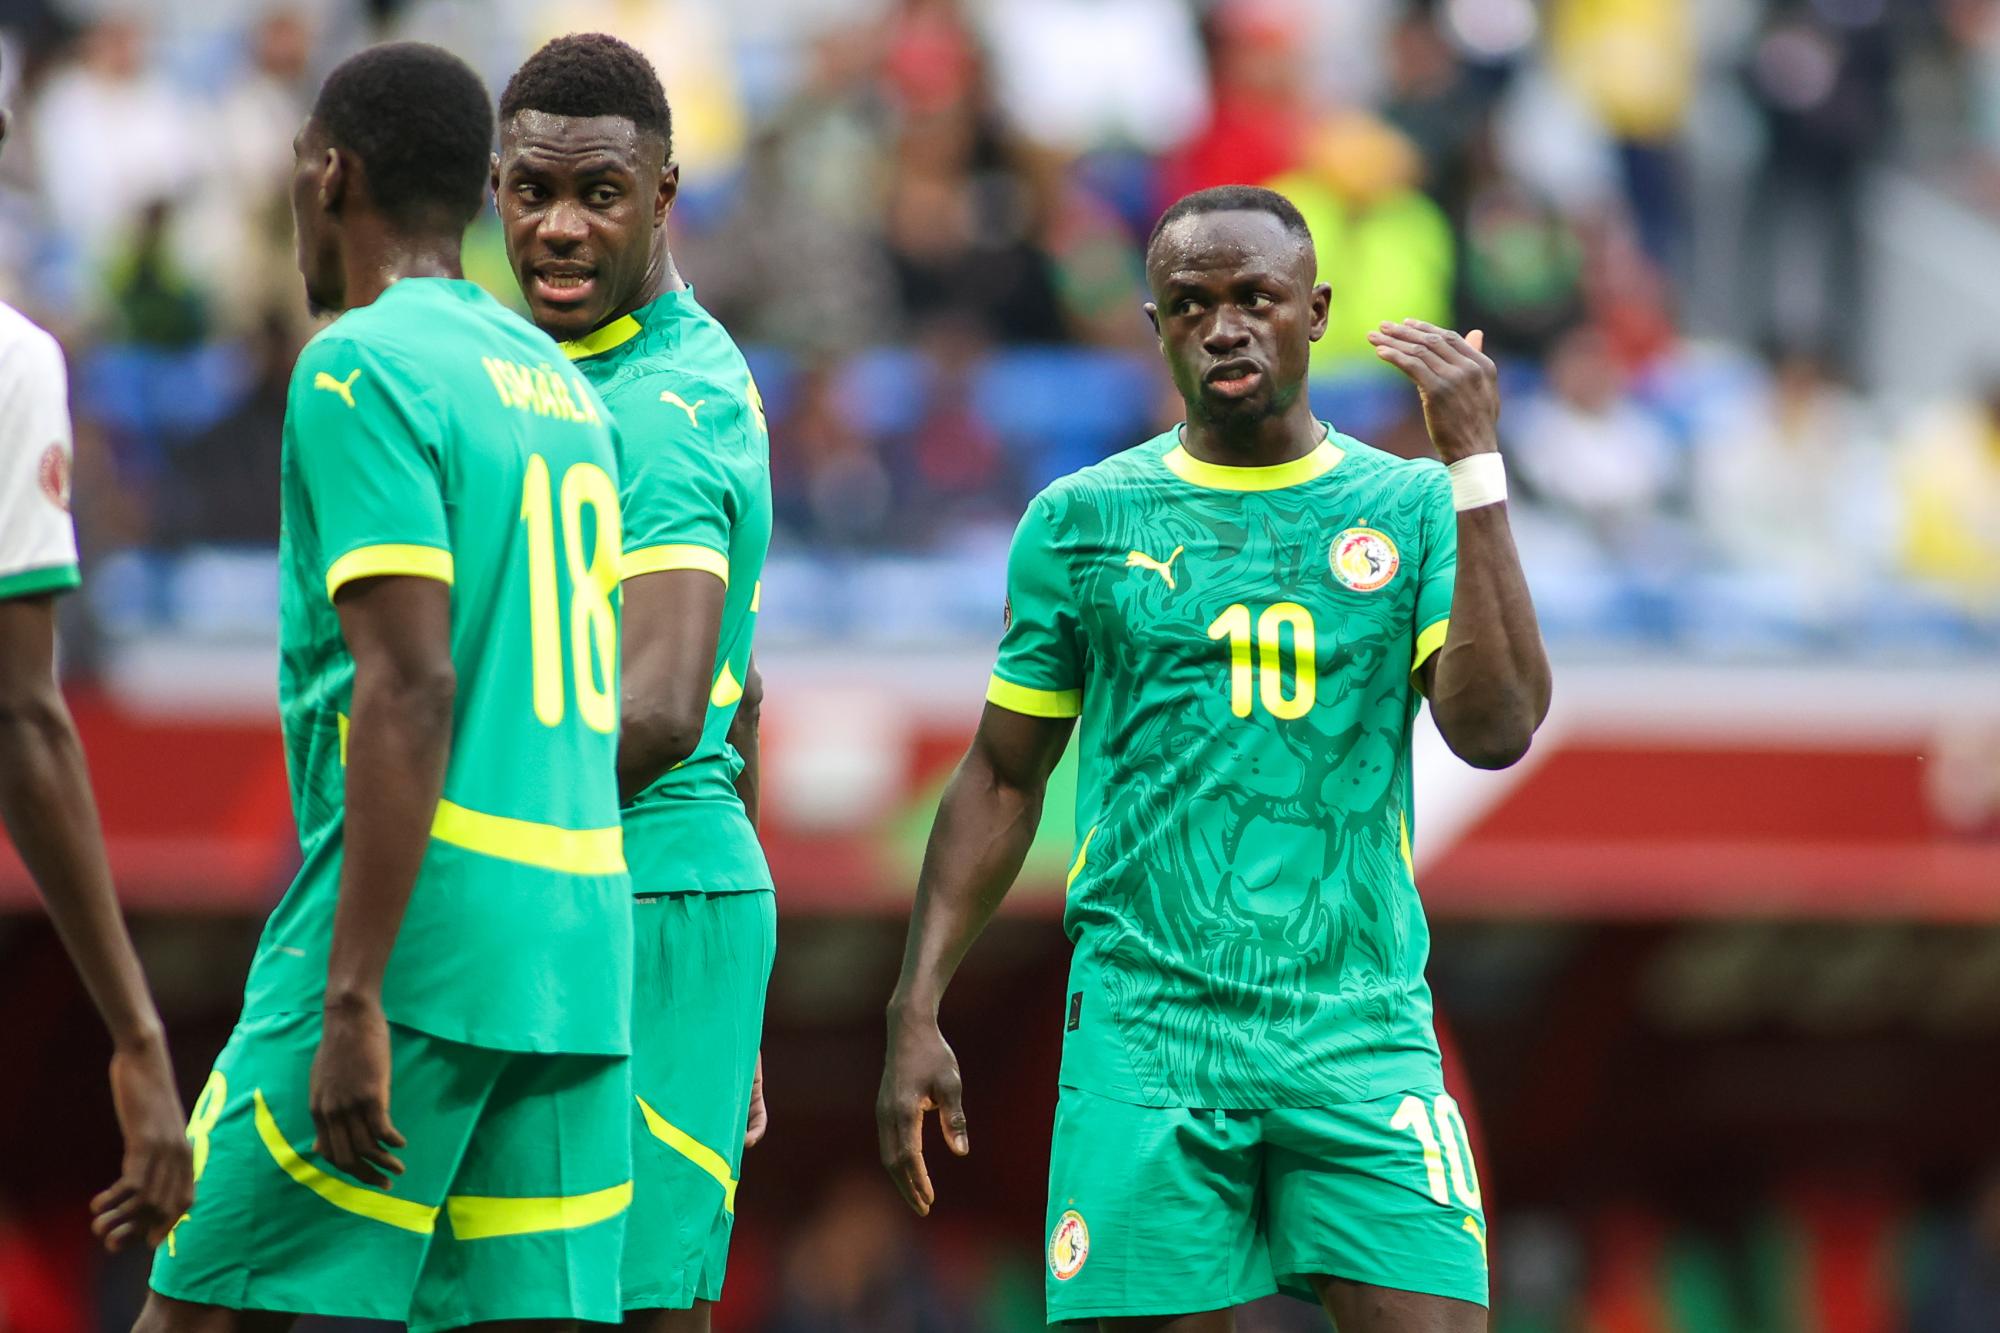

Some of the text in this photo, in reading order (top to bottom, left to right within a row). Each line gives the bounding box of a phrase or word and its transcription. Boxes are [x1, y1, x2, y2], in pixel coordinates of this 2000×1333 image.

[520, 452, 622, 734] 18
[1207, 601, 1317, 720] 10
[1389, 1094, 1482, 1210] 10
